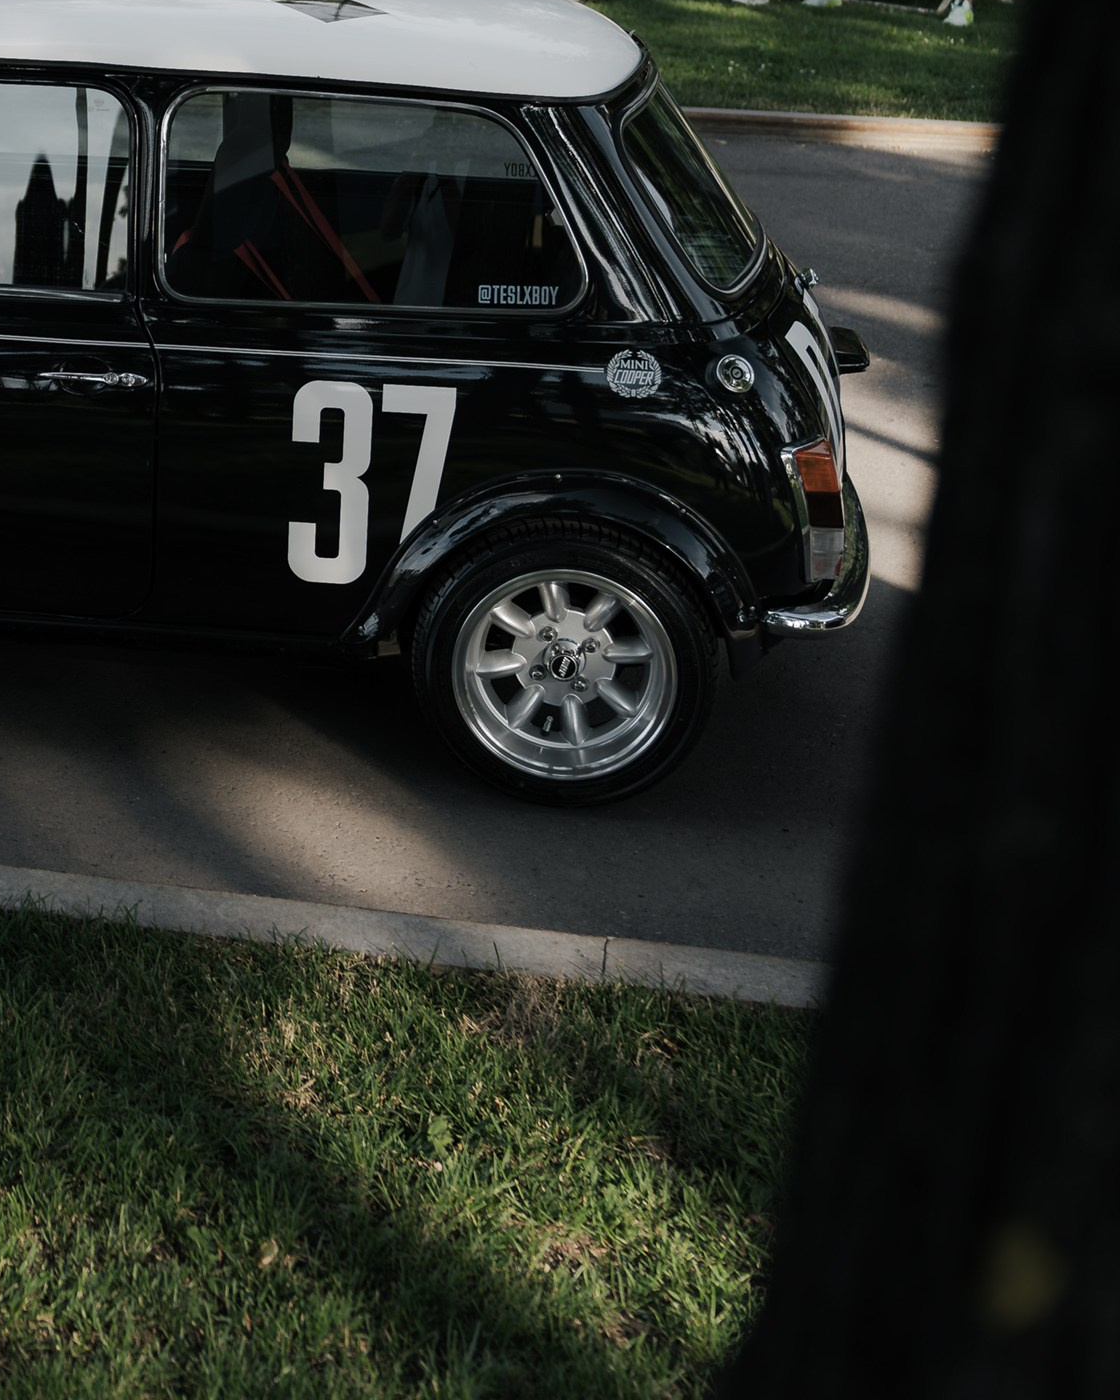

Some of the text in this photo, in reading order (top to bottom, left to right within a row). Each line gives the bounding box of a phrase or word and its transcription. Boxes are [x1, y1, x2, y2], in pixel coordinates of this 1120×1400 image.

[478, 284, 559, 305] @TESLXBOY
[620, 359, 649, 370] MINI
[613, 369, 655, 385] COOPER
[287, 380, 457, 585] 37
